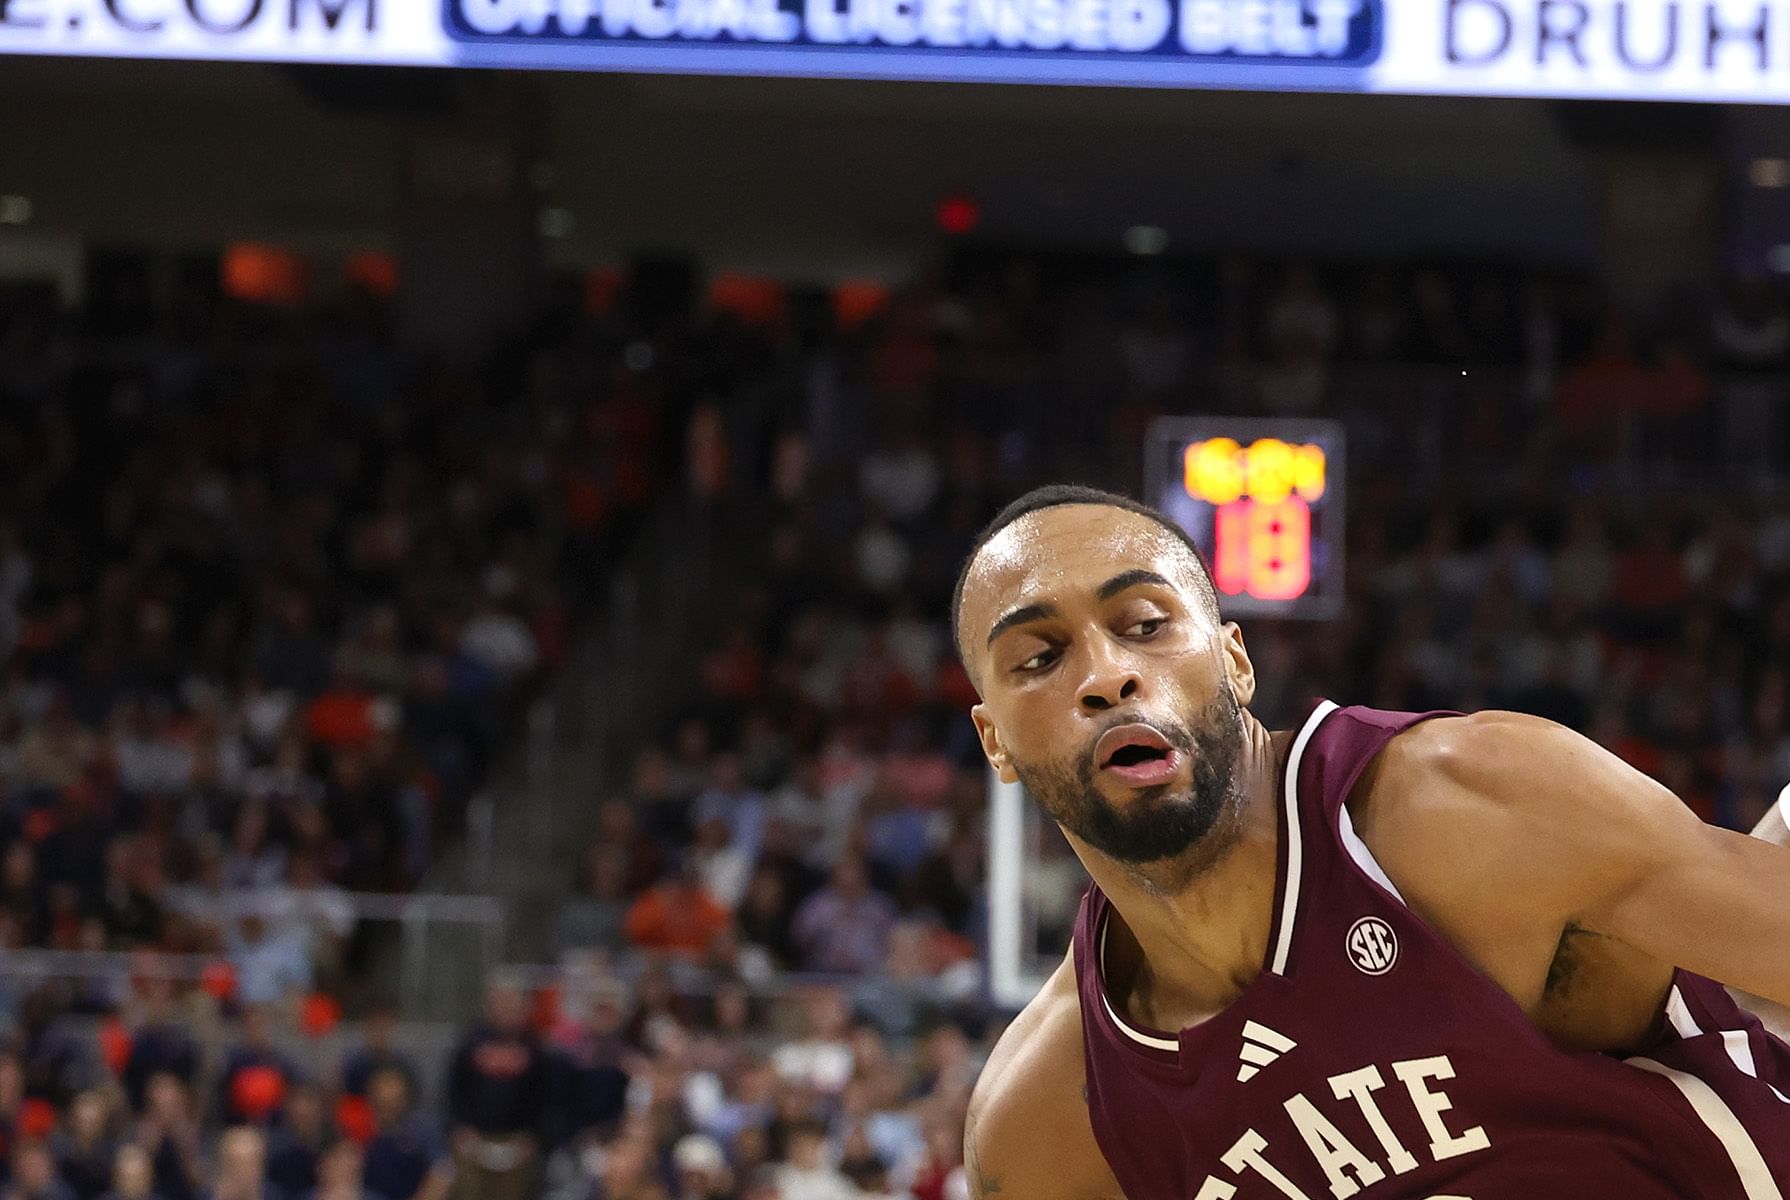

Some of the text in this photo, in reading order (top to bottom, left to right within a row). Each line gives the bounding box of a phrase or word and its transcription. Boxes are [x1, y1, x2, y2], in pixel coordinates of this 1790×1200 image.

[804, 0, 1172, 53] LICENSED
[1178, 0, 1360, 58] BELT
[1351, 921, 1393, 970] SEC
